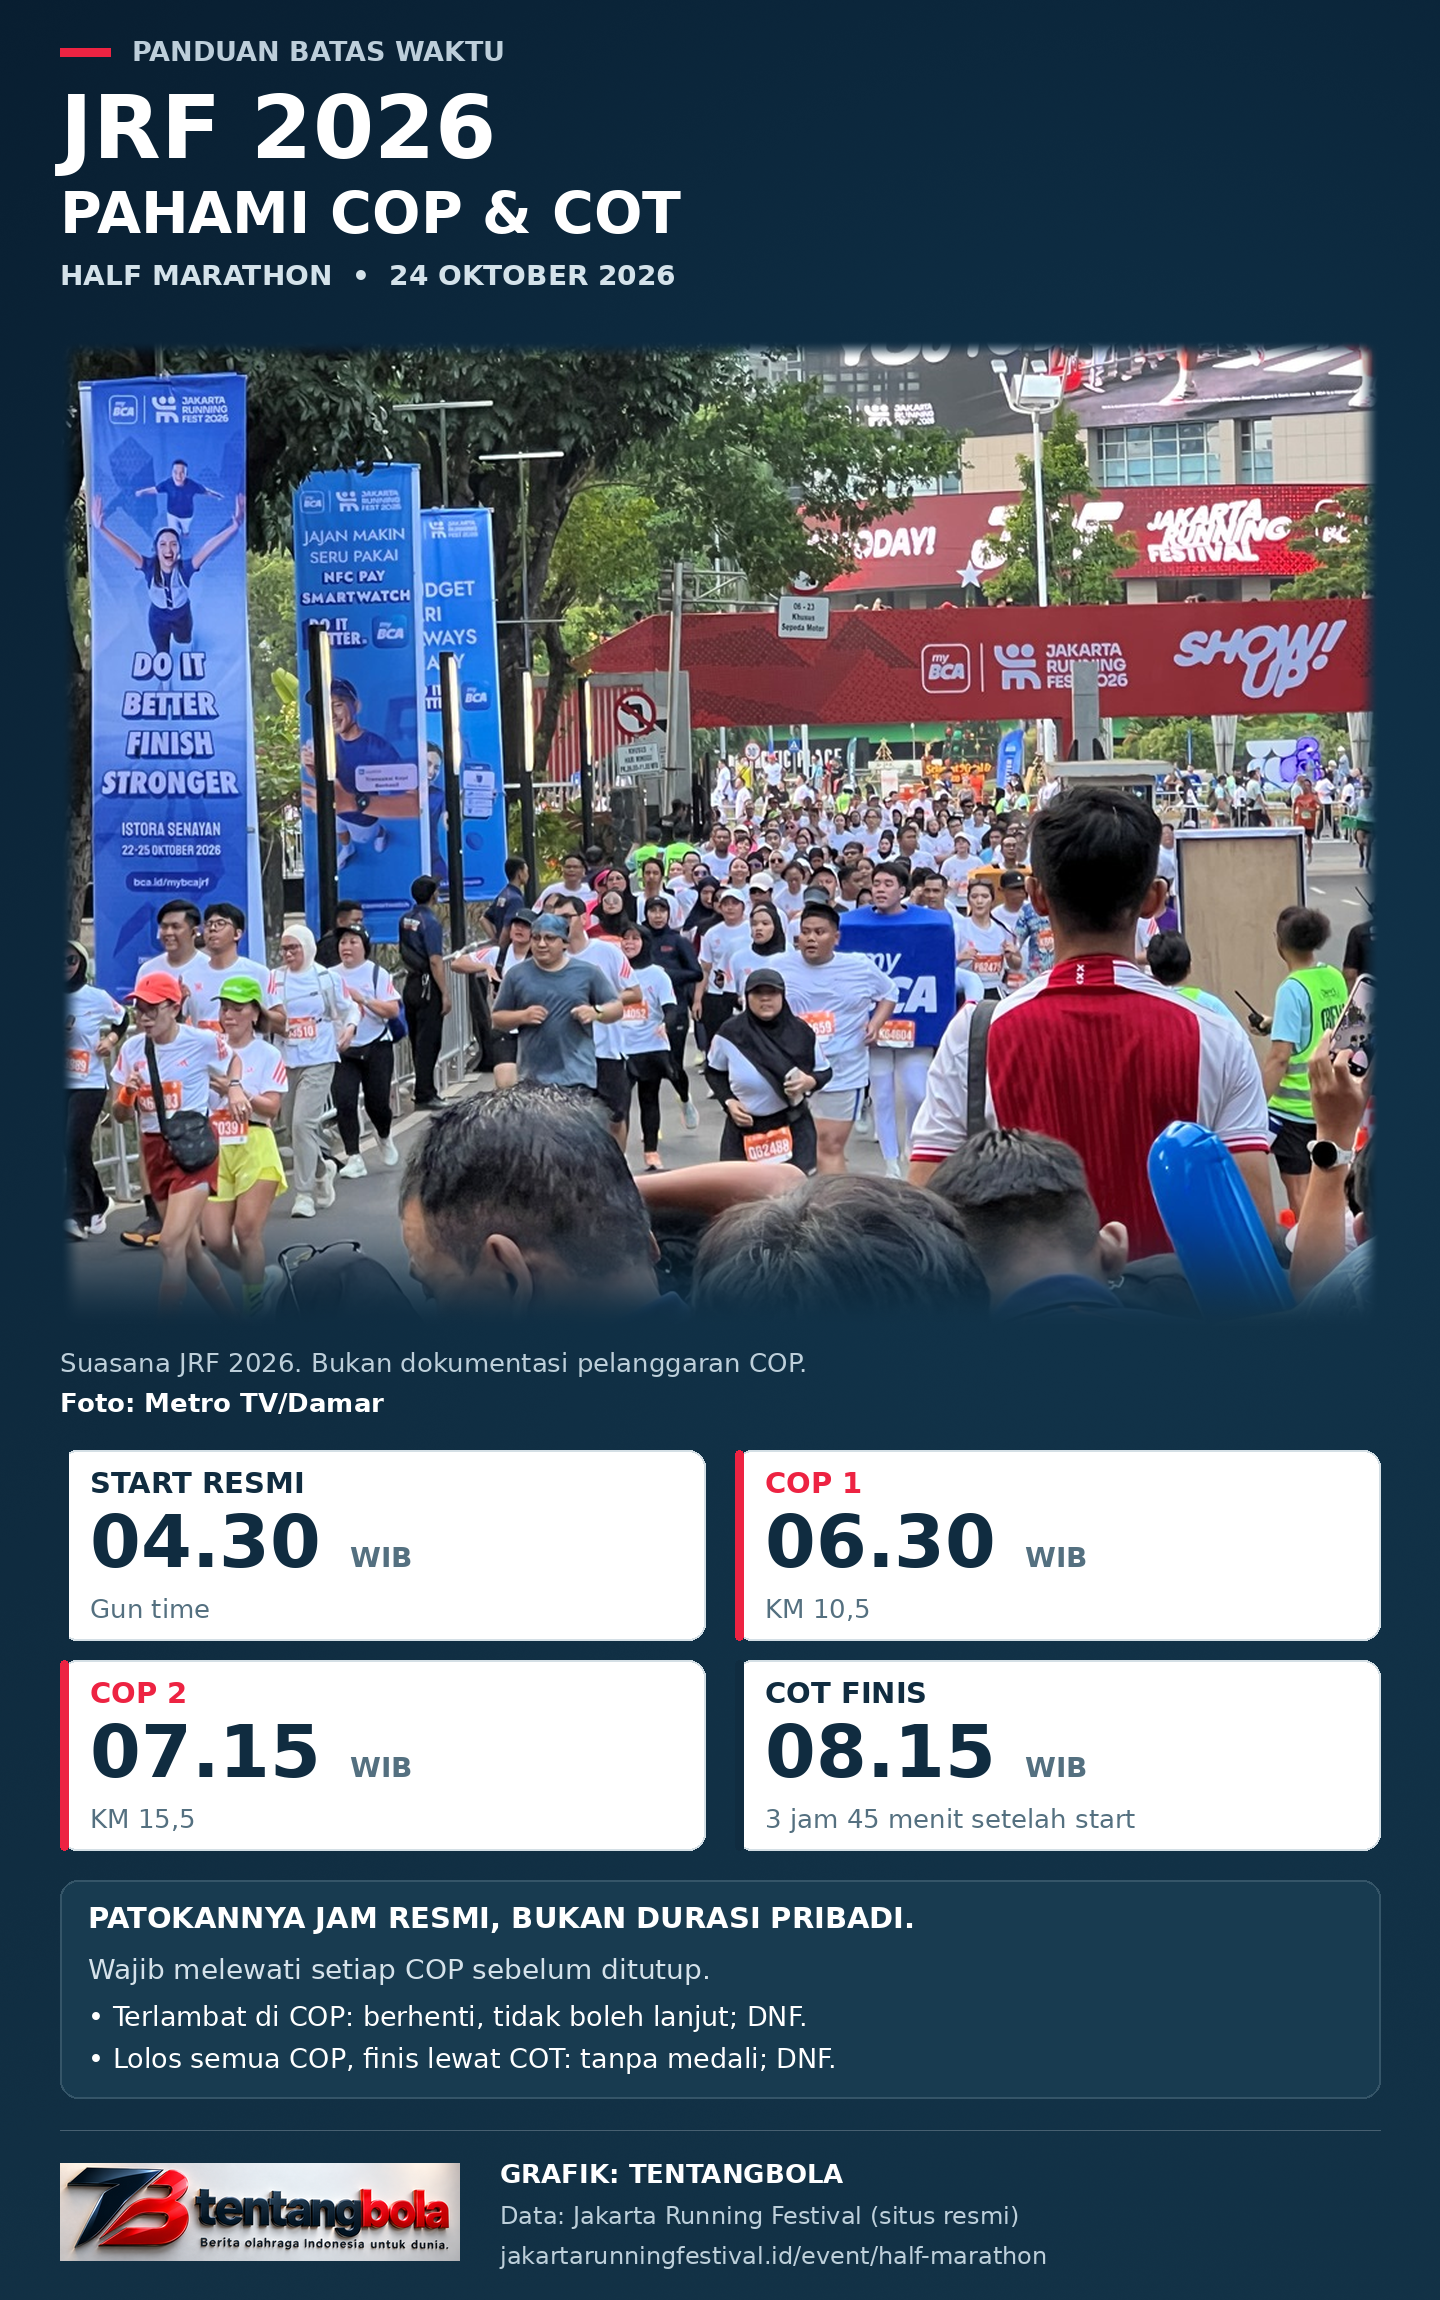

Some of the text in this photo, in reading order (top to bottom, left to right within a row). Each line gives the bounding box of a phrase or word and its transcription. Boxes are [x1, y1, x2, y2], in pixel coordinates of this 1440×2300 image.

[182, 396, 226, 406] JAKARTA
[113, 406, 134, 417] BCA
[182, 405, 228, 415] RUNNING
[182, 414, 230, 424] FEST 2026
[361, 490, 399, 498] JAKARTA
[361, 496, 401, 504] RUNNING
[361, 504, 380, 512] FEST
[1146, 498, 1262, 531] JAKARTA
[302, 528, 406, 547] JAJAN MAKIN
[1162, 514, 1293, 547] RUNNING
[310, 549, 399, 564] SERU PAKAI
[1147, 543, 1260, 563] FESTIVAL
[324, 570, 386, 584] NFC PAY
[301, 590, 411, 605] SMARTWATCH
[423, 606, 442, 622] RI
[791, 613, 815, 621] Khusus
[335, 618, 348, 631] IT
[781, 623, 825, 632] Sepeda Motor
[377, 629, 405, 640] BCA
[1046, 642, 1122, 658] JAKARTA
[1173, 619, 1348, 670] SHOW!
[132, 652, 206, 680] DO IT
[932, 653, 950, 664] my
[1046, 657, 1127, 673] RUING
[928, 664, 965, 680] BCA
[1242, 650, 1310, 699] UP
[1046, 673, 1129, 689] FES 026
[123, 691, 219, 719] BETTER
[464, 692, 488, 703] BCA
[126, 730, 215, 758] FINISH
[101, 770, 239, 798] STRONGER
[121, 822, 221, 837] ISTORA SENAYAN
[121, 844, 222, 857] 22-25 OKTOBER 2026
[133, 876, 210, 890] bca.id/mybcajrf
[866, 952, 902, 975] my
[888, 976, 938, 1014] CA
